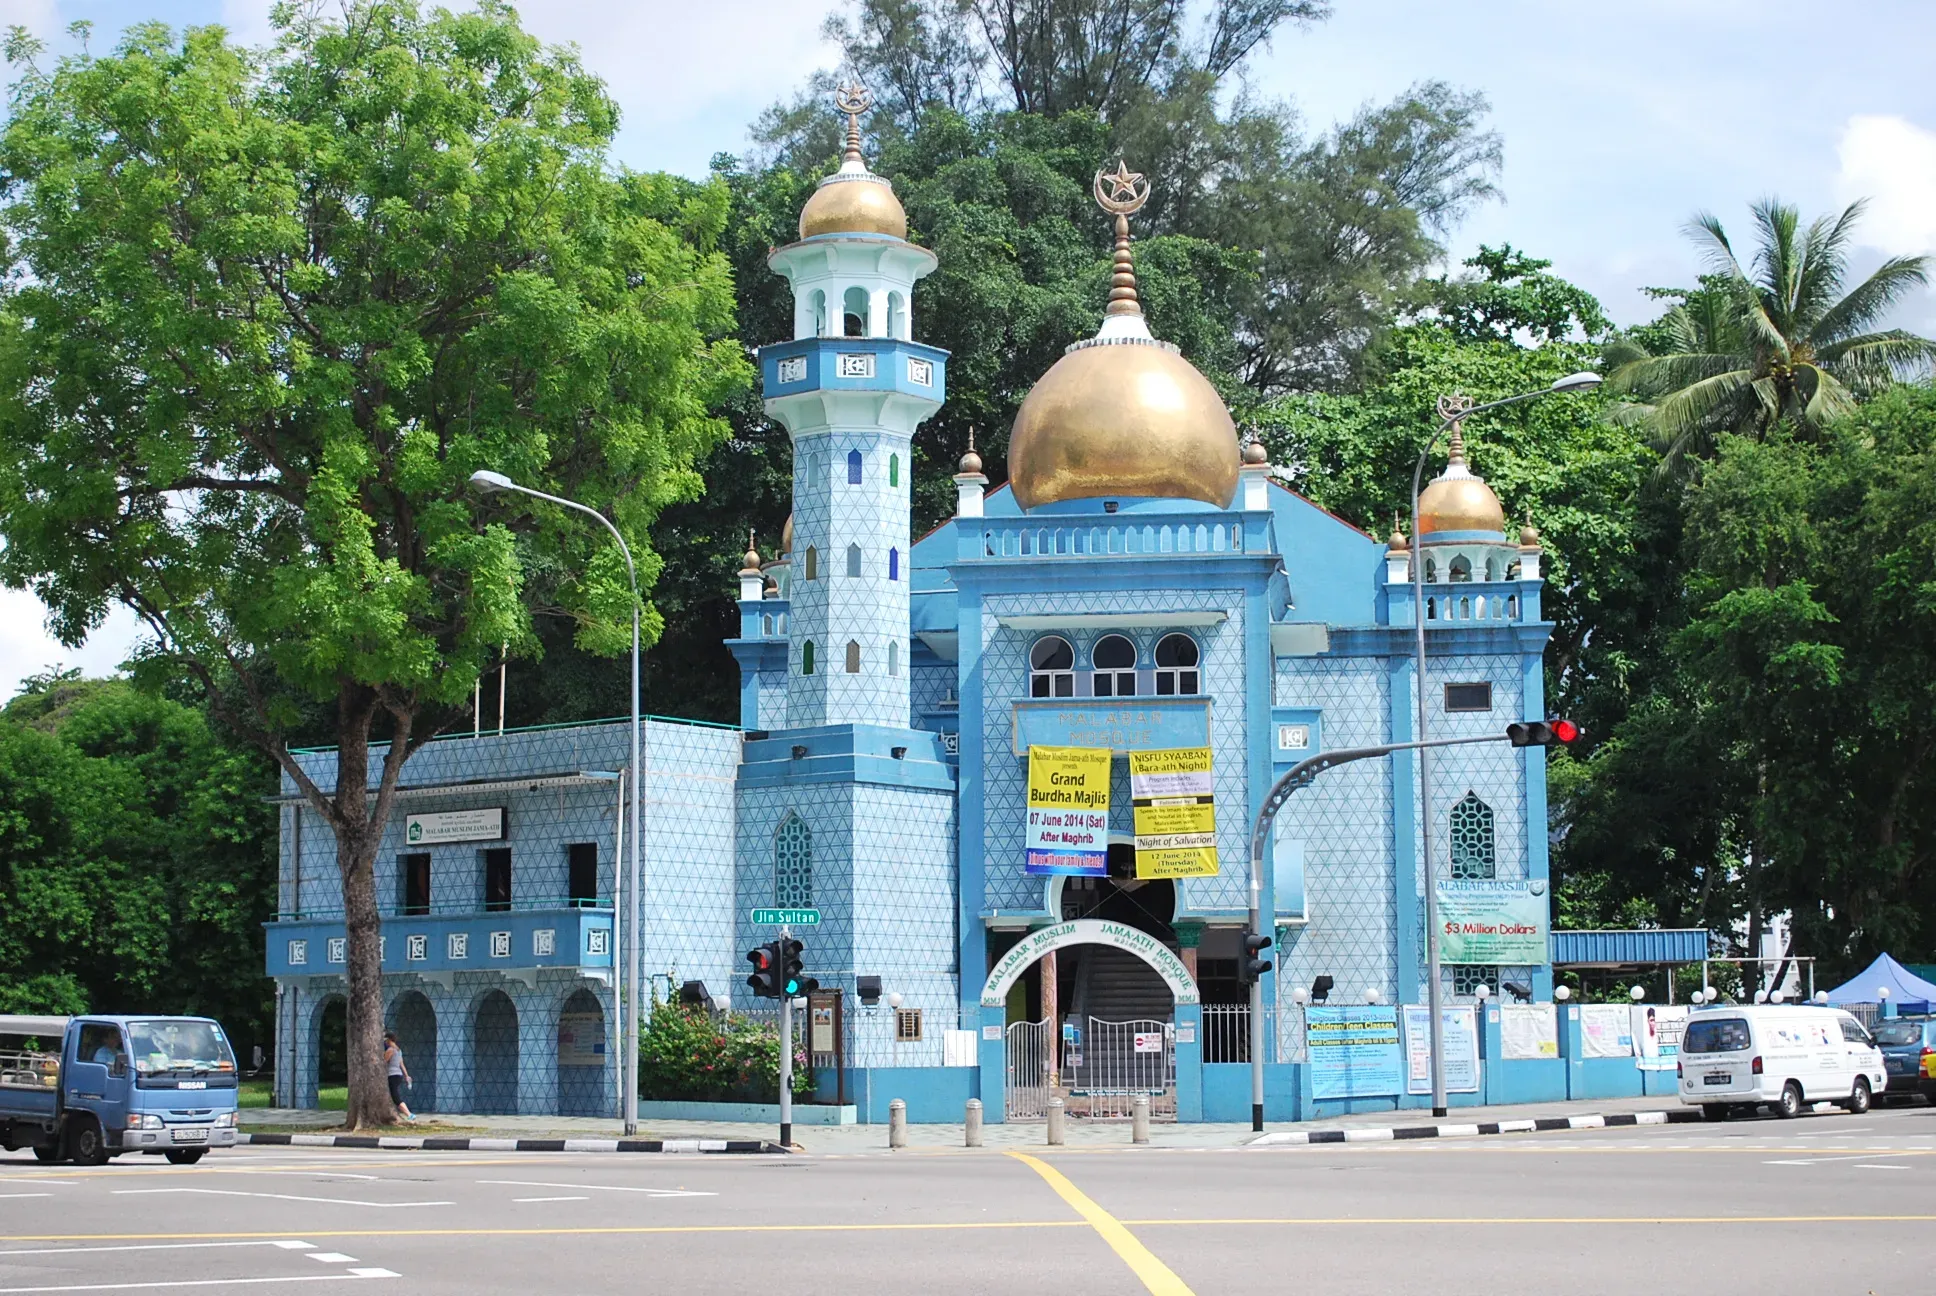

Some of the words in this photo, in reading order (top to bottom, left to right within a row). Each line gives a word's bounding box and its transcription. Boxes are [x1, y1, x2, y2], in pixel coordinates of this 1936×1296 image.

[1058, 711, 1162, 726] MALABAR
[1069, 731, 1152, 744] MOSQUE
[1135, 753, 1161, 762] NISFU
[1163, 751, 1207, 761] SYAABAN
[1135, 762, 1176, 773] (Bara-ath
[1177, 761, 1207, 772] Night)
[1051, 772, 1085, 786] Grand
[1031, 788, 1072, 803] Burdha
[1074, 790, 1106, 808] Majlis
[1029, 812, 1039, 825] 07
[1042, 813, 1061, 826] June
[1064, 813, 1084, 827] 2014
[1086, 815, 1105, 831] (Sat)
[1040, 831, 1059, 842] After
[1062, 832, 1094, 846] Maghrib
[1163, 837, 1173, 847] of
[1158, 859, 1197, 867] (Thursday)
[1437, 881, 1484, 891] ALABAR
[1488, 881, 1529, 891] MASJID
[757, 911, 774, 923] Jln
[778, 911, 814, 923] Sultan
[1444, 921, 1460, 935] $3
[1462, 922, 1497, 934] Million
[1499, 923, 1536, 935] Dollars
[988, 944, 1031, 991] MALABAR
[1033, 924, 1076, 946] MUSLIM
[1100, 923, 1155, 950] JAMA-ATH
[1156, 948, 1192, 990] MOSQUE
[1178, 995, 1196, 1003] MMJ
[1365, 1021, 1394, 1029] Classes
[178, 1081, 206, 1089] NISSAN
